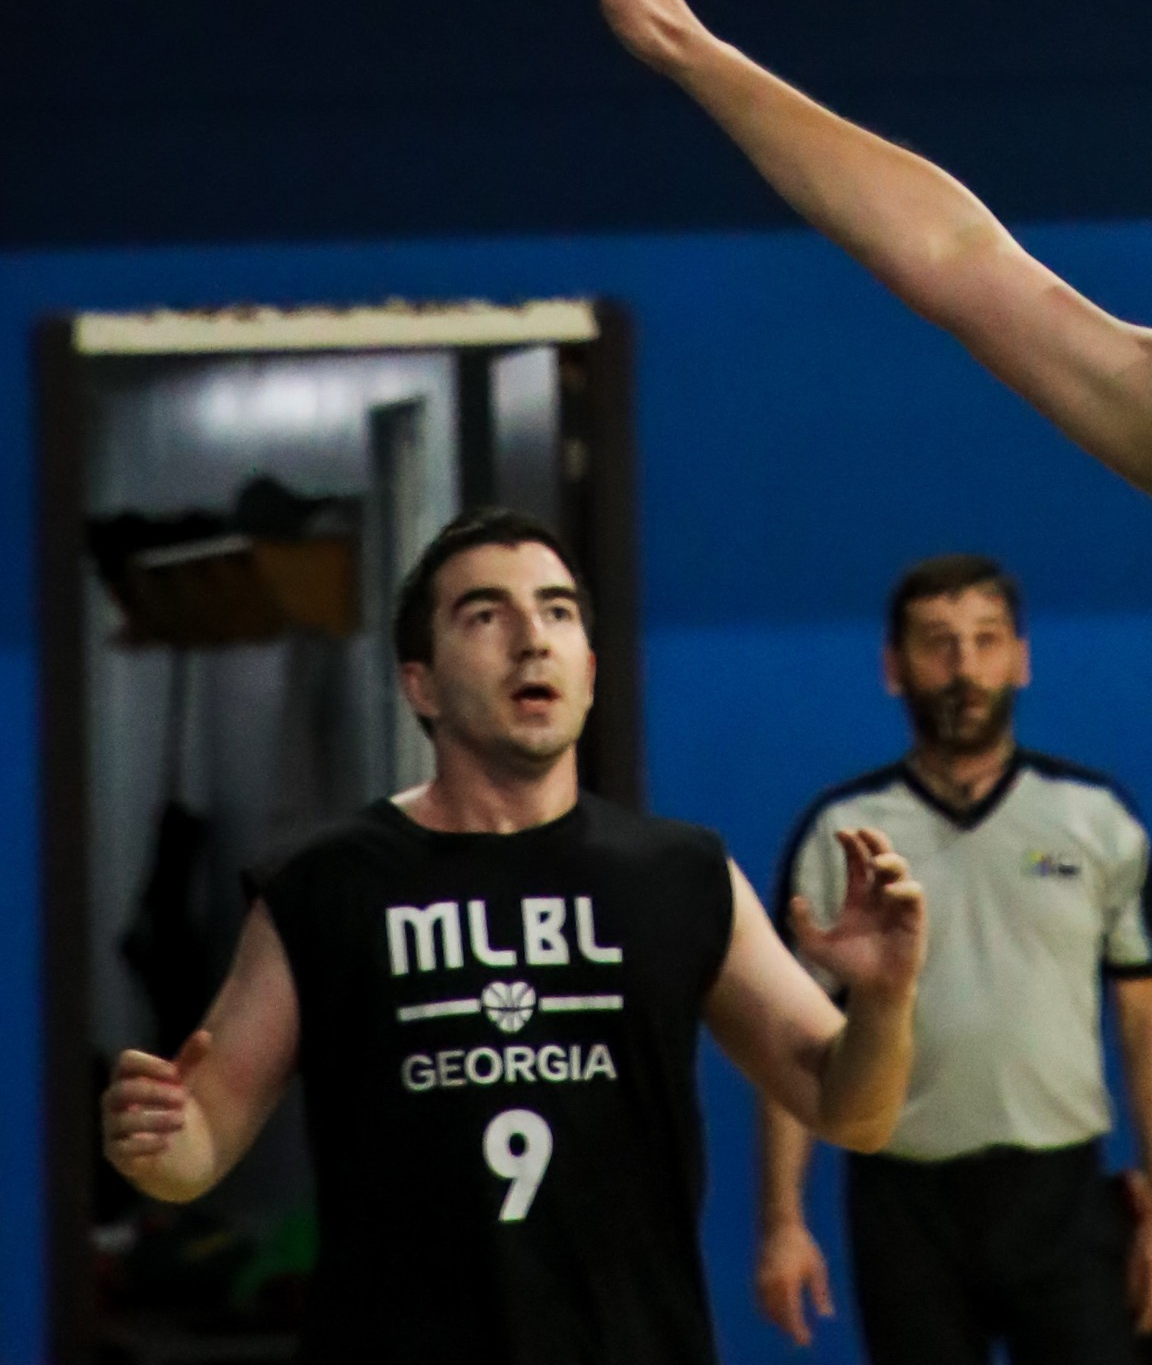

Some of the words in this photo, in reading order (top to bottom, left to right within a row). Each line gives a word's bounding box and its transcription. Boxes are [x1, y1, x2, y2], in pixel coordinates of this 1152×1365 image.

[384, 895, 624, 977] MLBL
[401, 1043, 619, 1092] GEORGIA
[482, 1108, 554, 1222] 9
